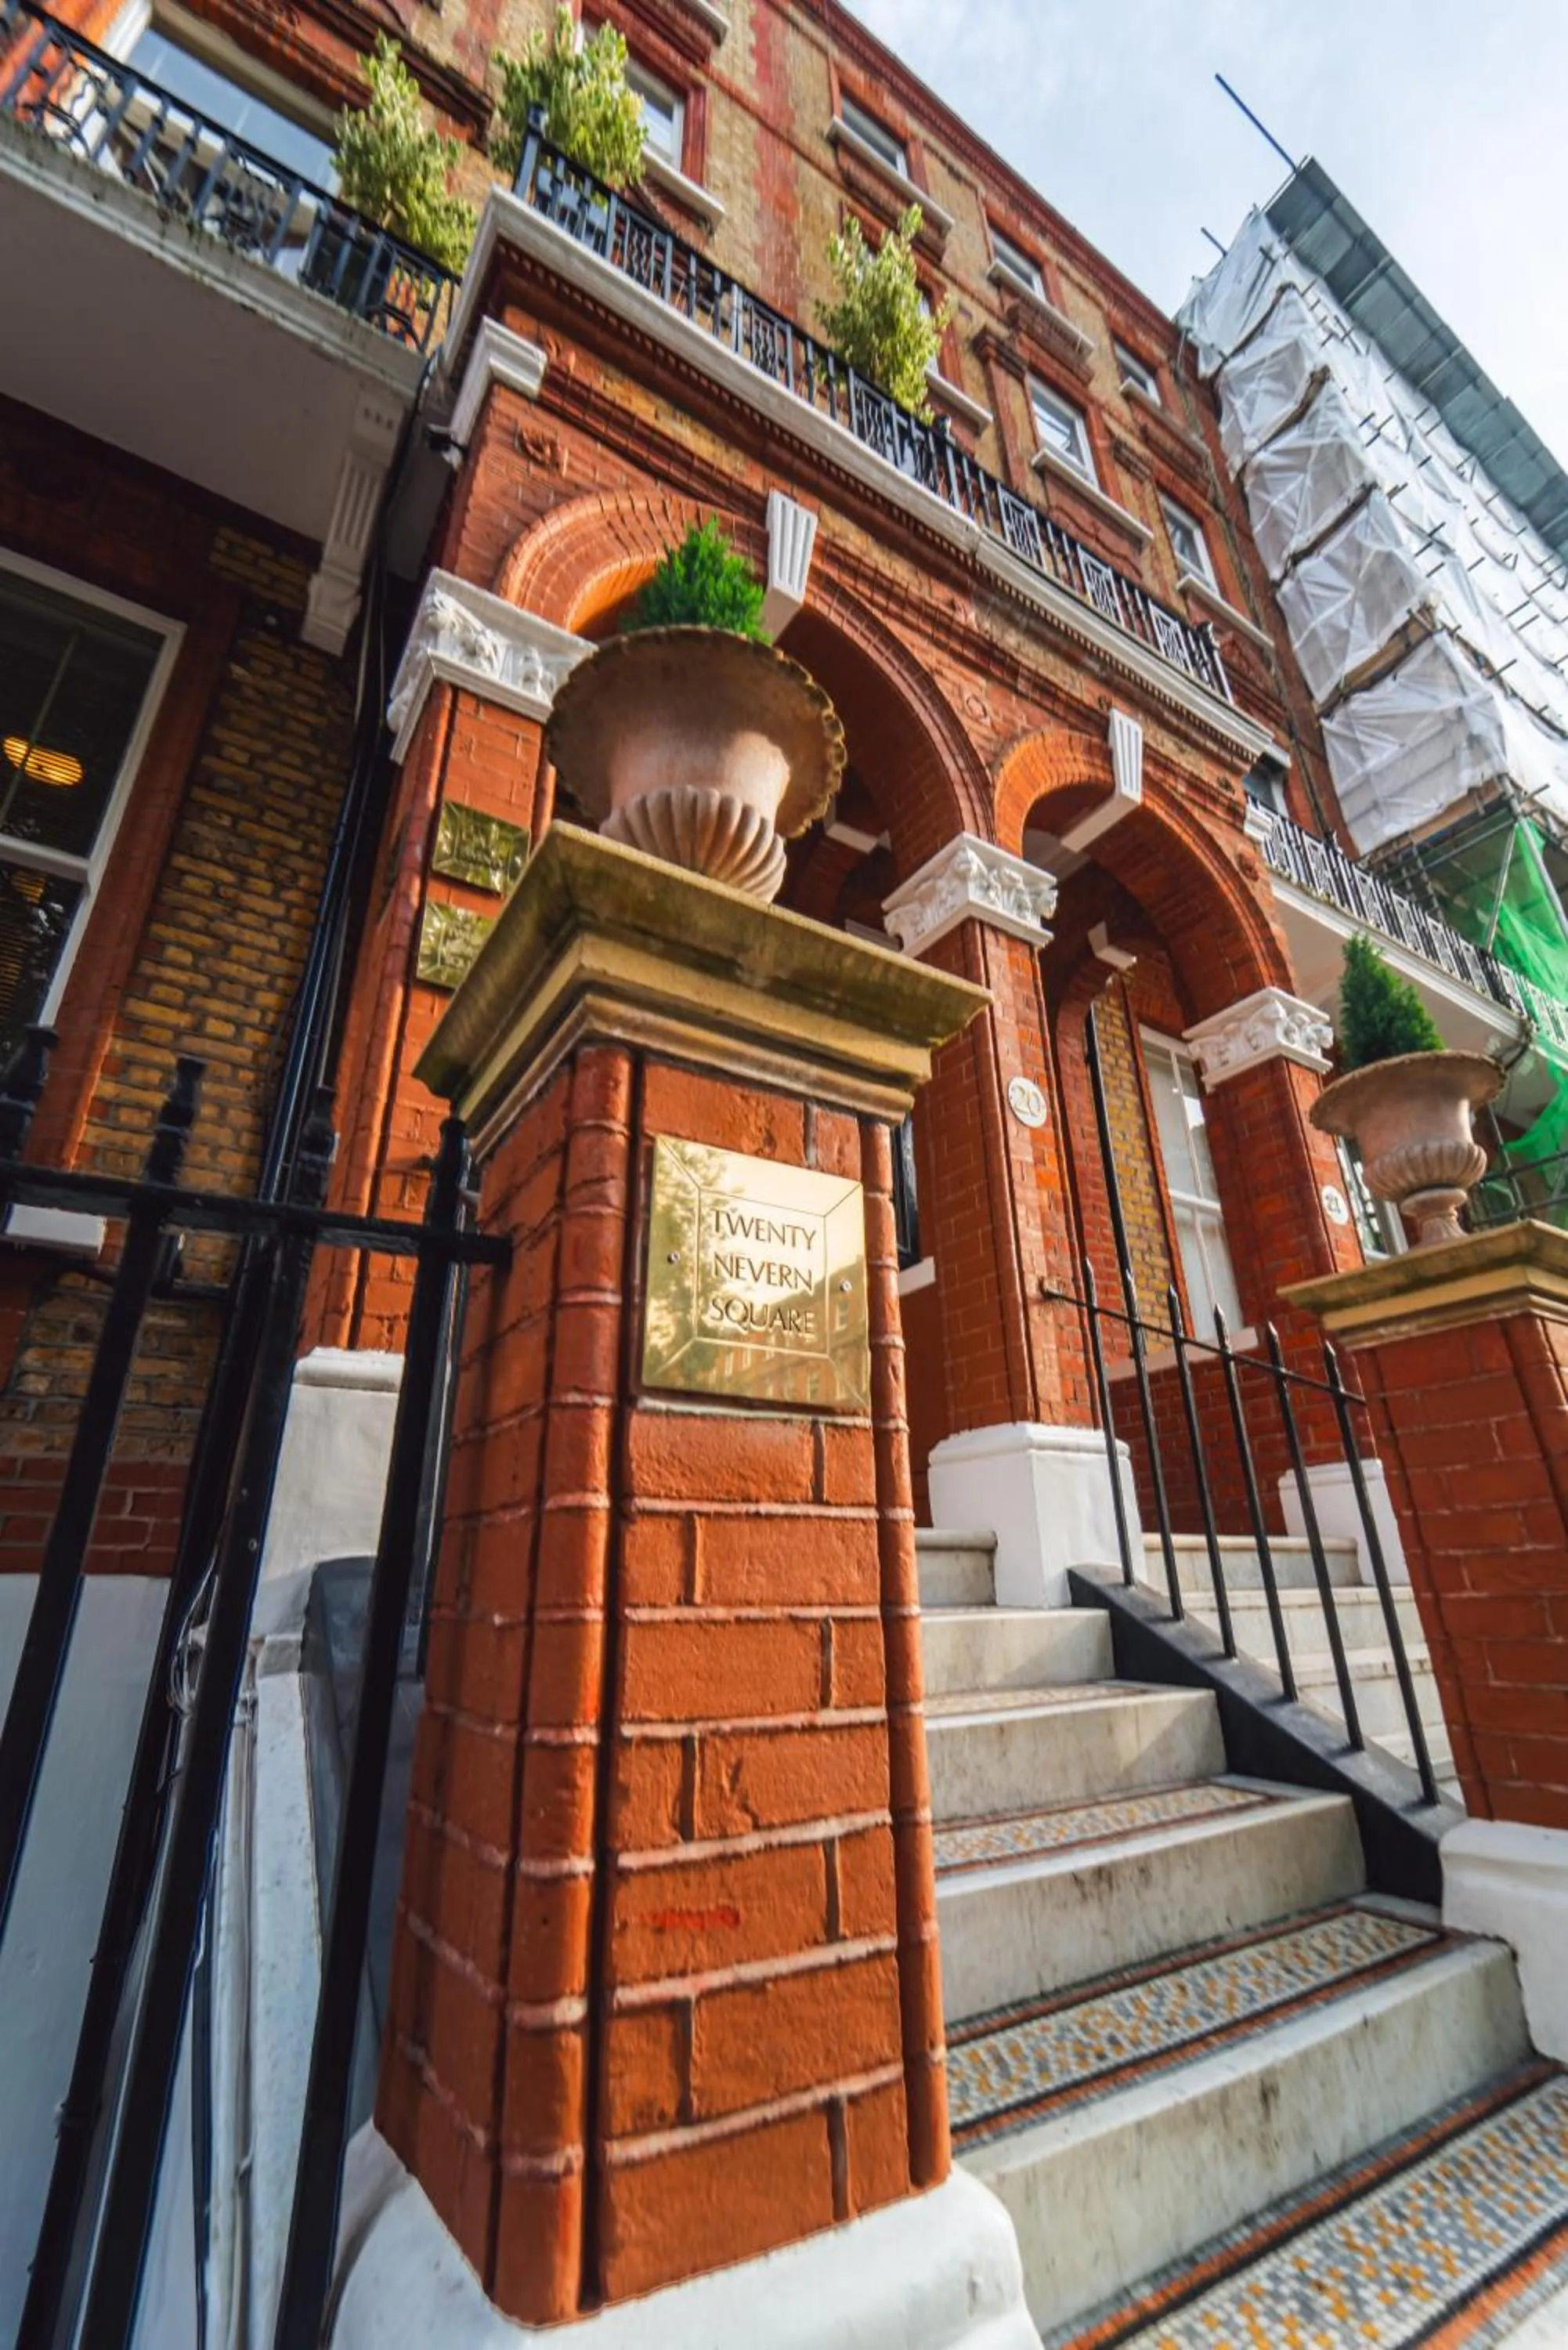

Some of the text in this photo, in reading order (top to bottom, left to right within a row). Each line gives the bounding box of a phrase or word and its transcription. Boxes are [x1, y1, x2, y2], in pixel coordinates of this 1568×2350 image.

[1012, 1085, 1041, 1117] 20
[712, 1209, 816, 1250] TWENTY
[714, 1253, 813, 1292] NEVERN
[710, 1298, 815, 1332] SQUARE
